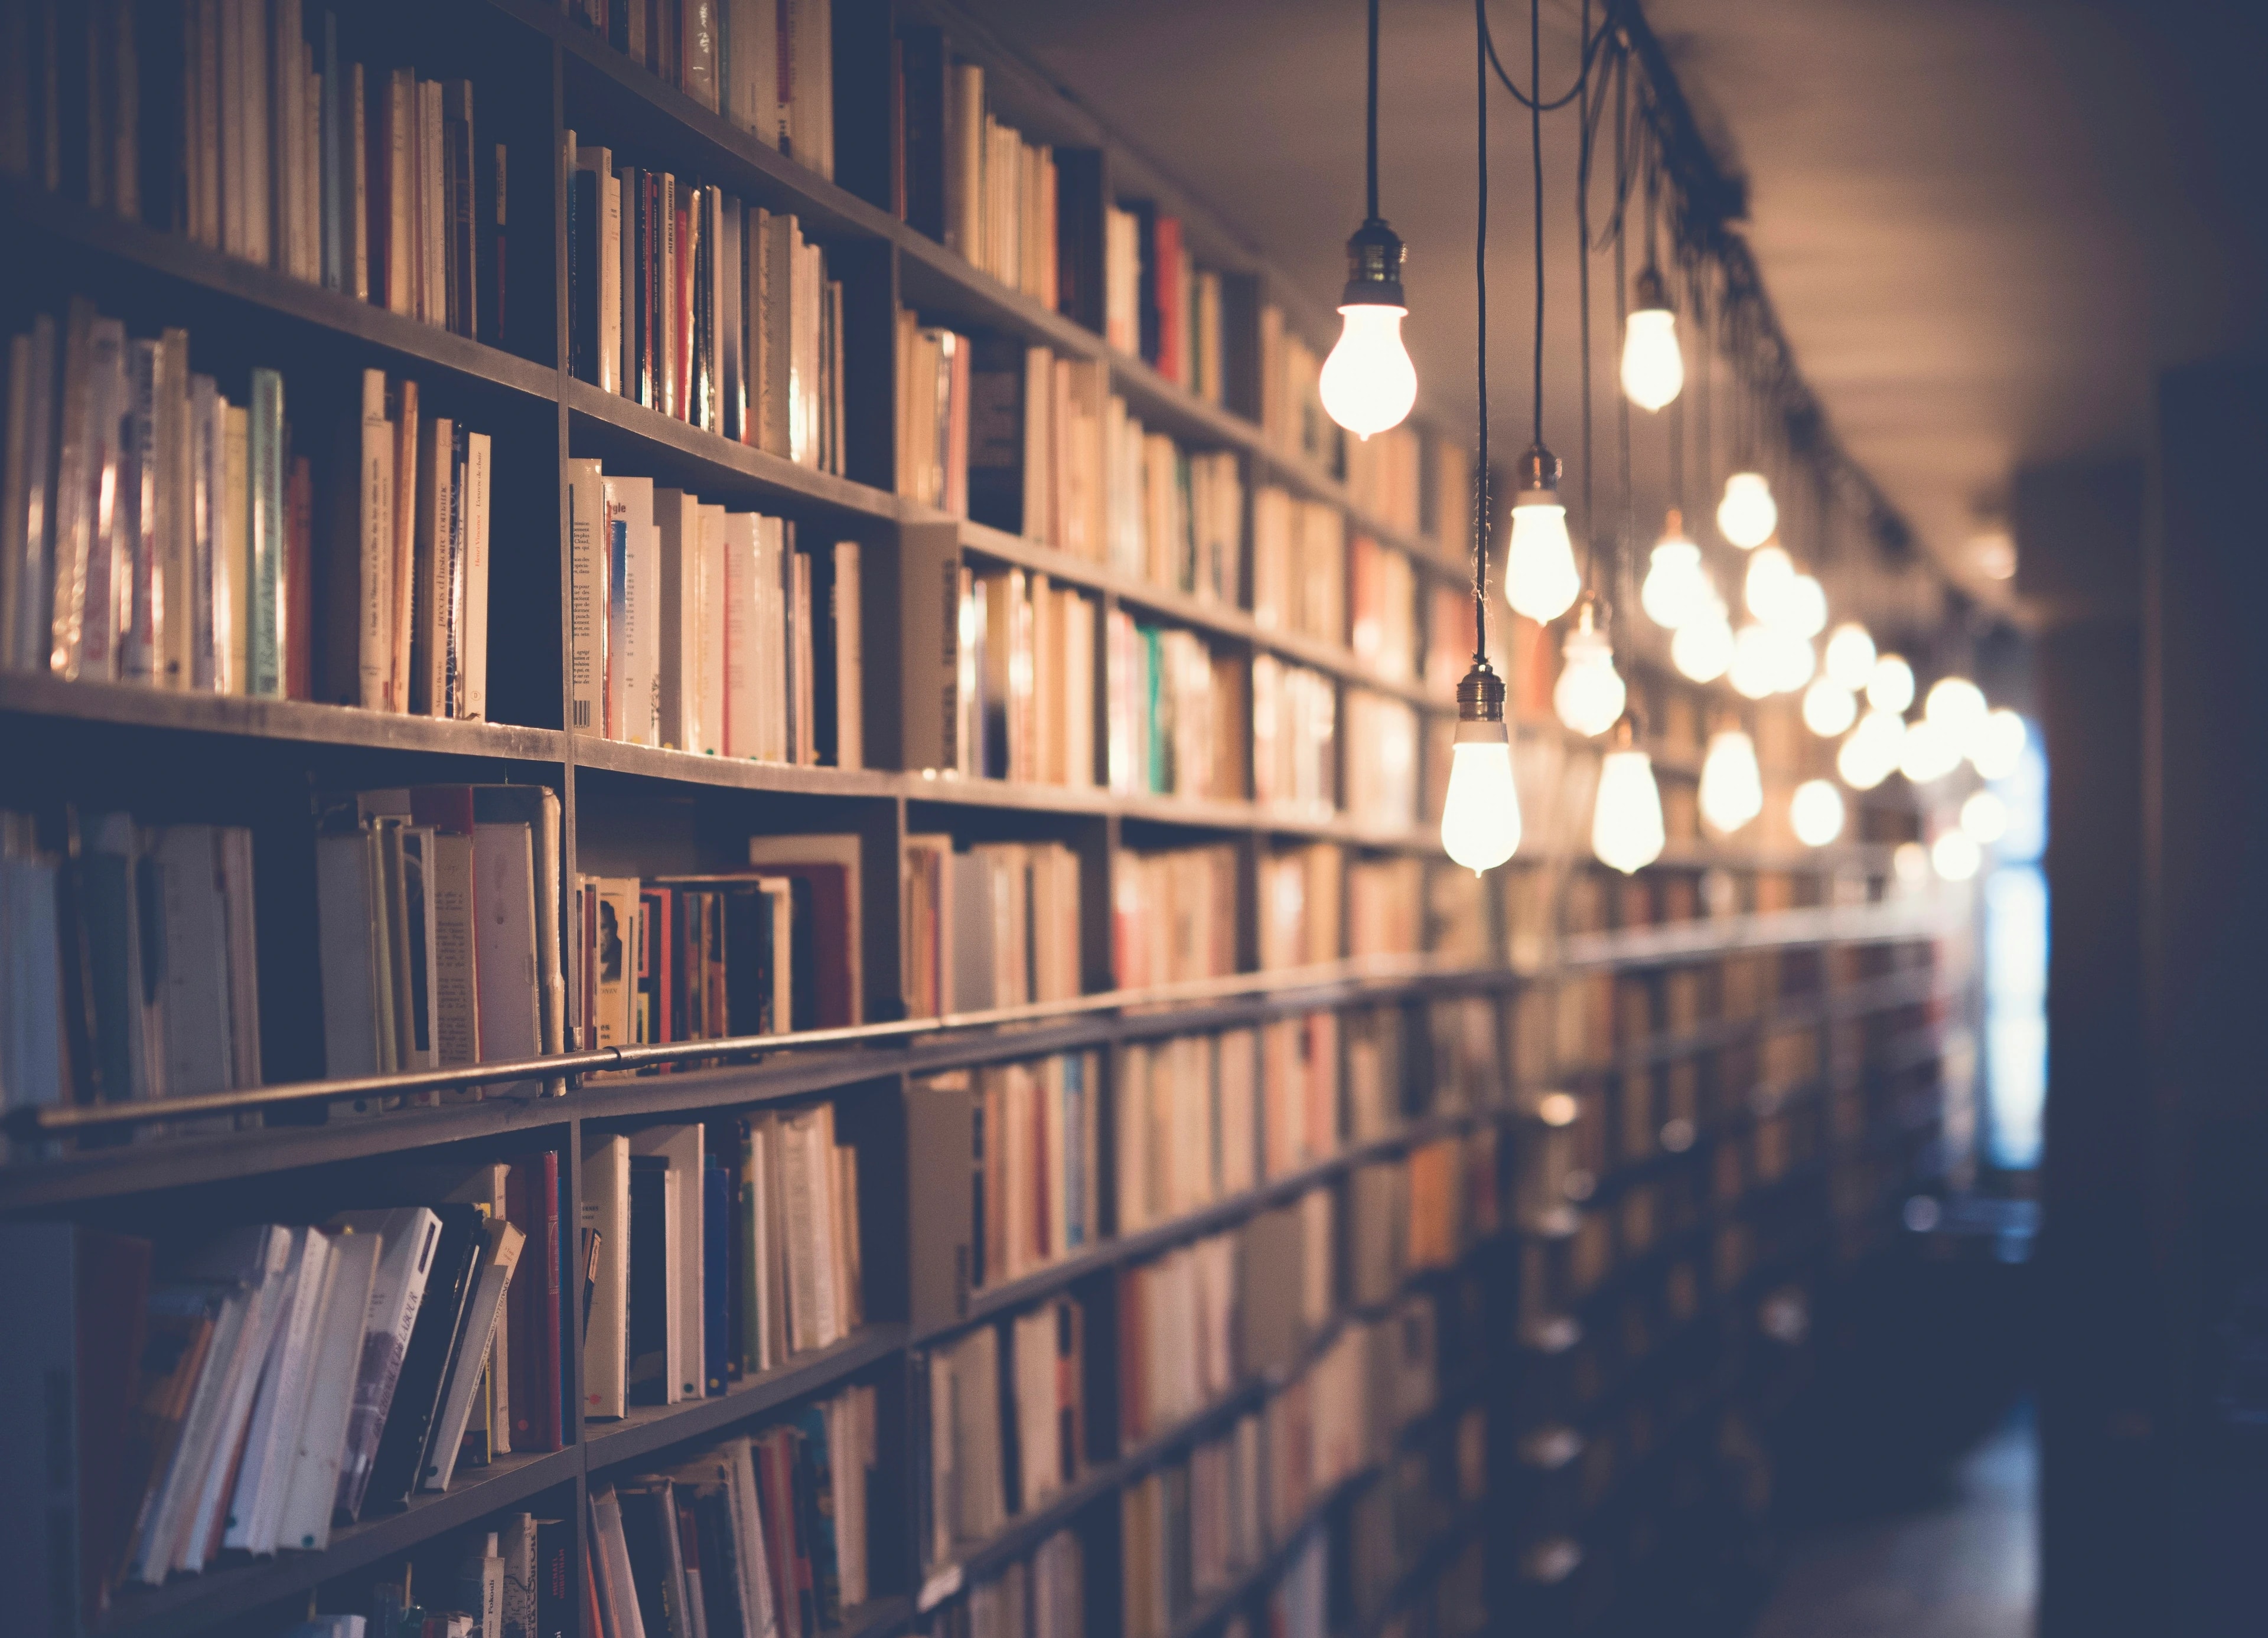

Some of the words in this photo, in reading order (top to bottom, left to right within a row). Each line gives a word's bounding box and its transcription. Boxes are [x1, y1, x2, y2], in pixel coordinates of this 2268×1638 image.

[476, 471, 481, 479] de
[437, 483, 447, 533] romaine
[436, 539, 446, 589] d'histoire
[436, 593, 446, 627] précis
[398, 1290, 418, 1342] LABOUR
[496, 1277, 510, 1319] DONATELLO
